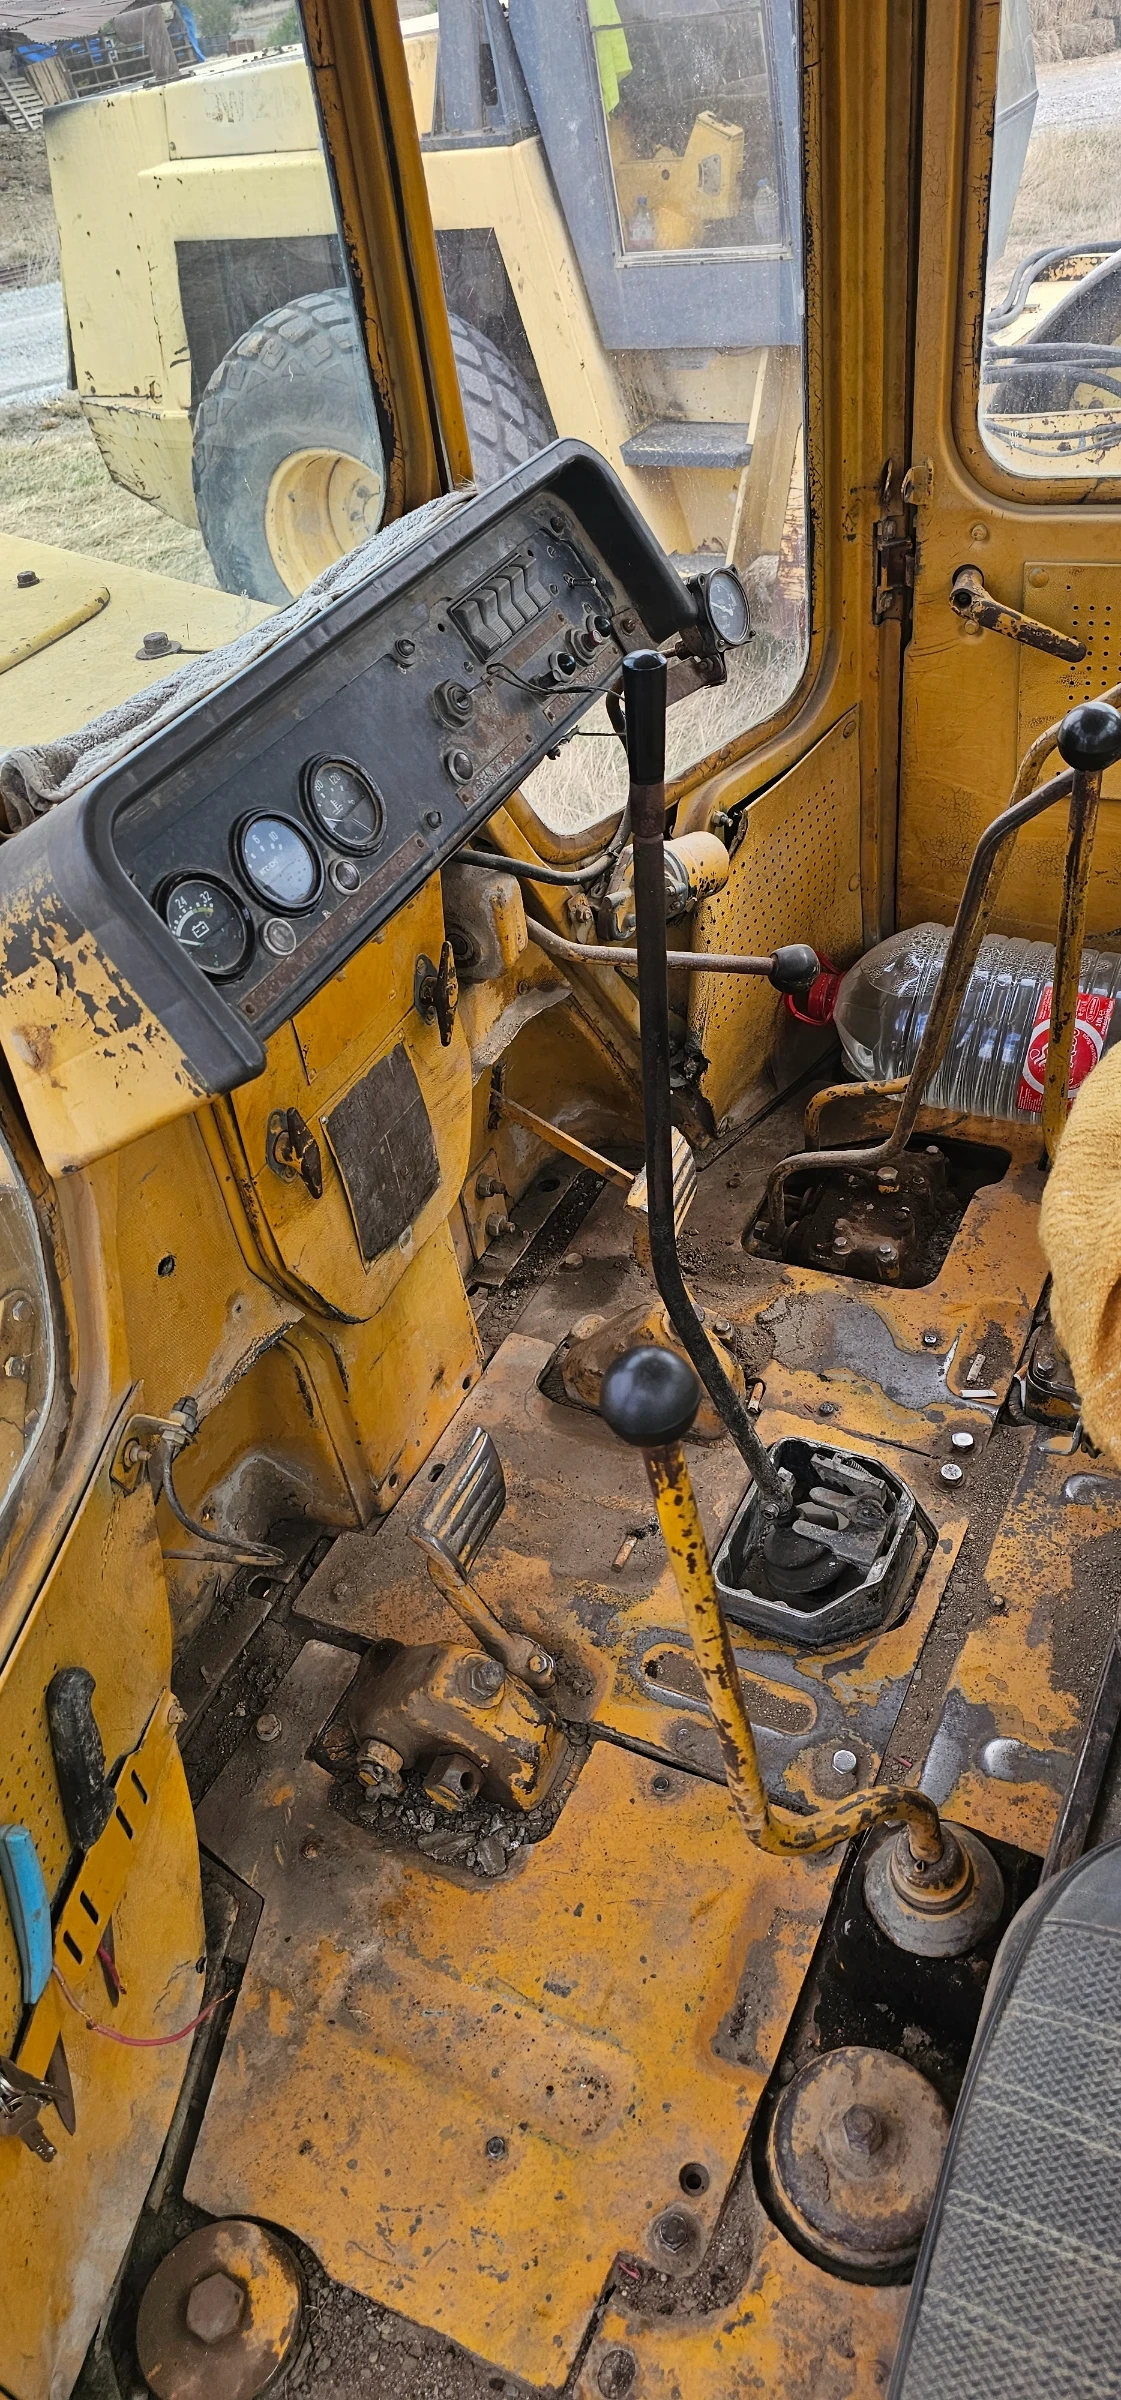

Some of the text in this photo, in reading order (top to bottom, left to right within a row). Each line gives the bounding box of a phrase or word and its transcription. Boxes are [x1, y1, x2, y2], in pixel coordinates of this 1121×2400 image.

[328, 772, 341, 786] 120
[251, 834, 261, 844] 6
[268, 831, 279, 842] 10
[174, 895, 188, 909] 24
[199, 890, 213, 903] 32
